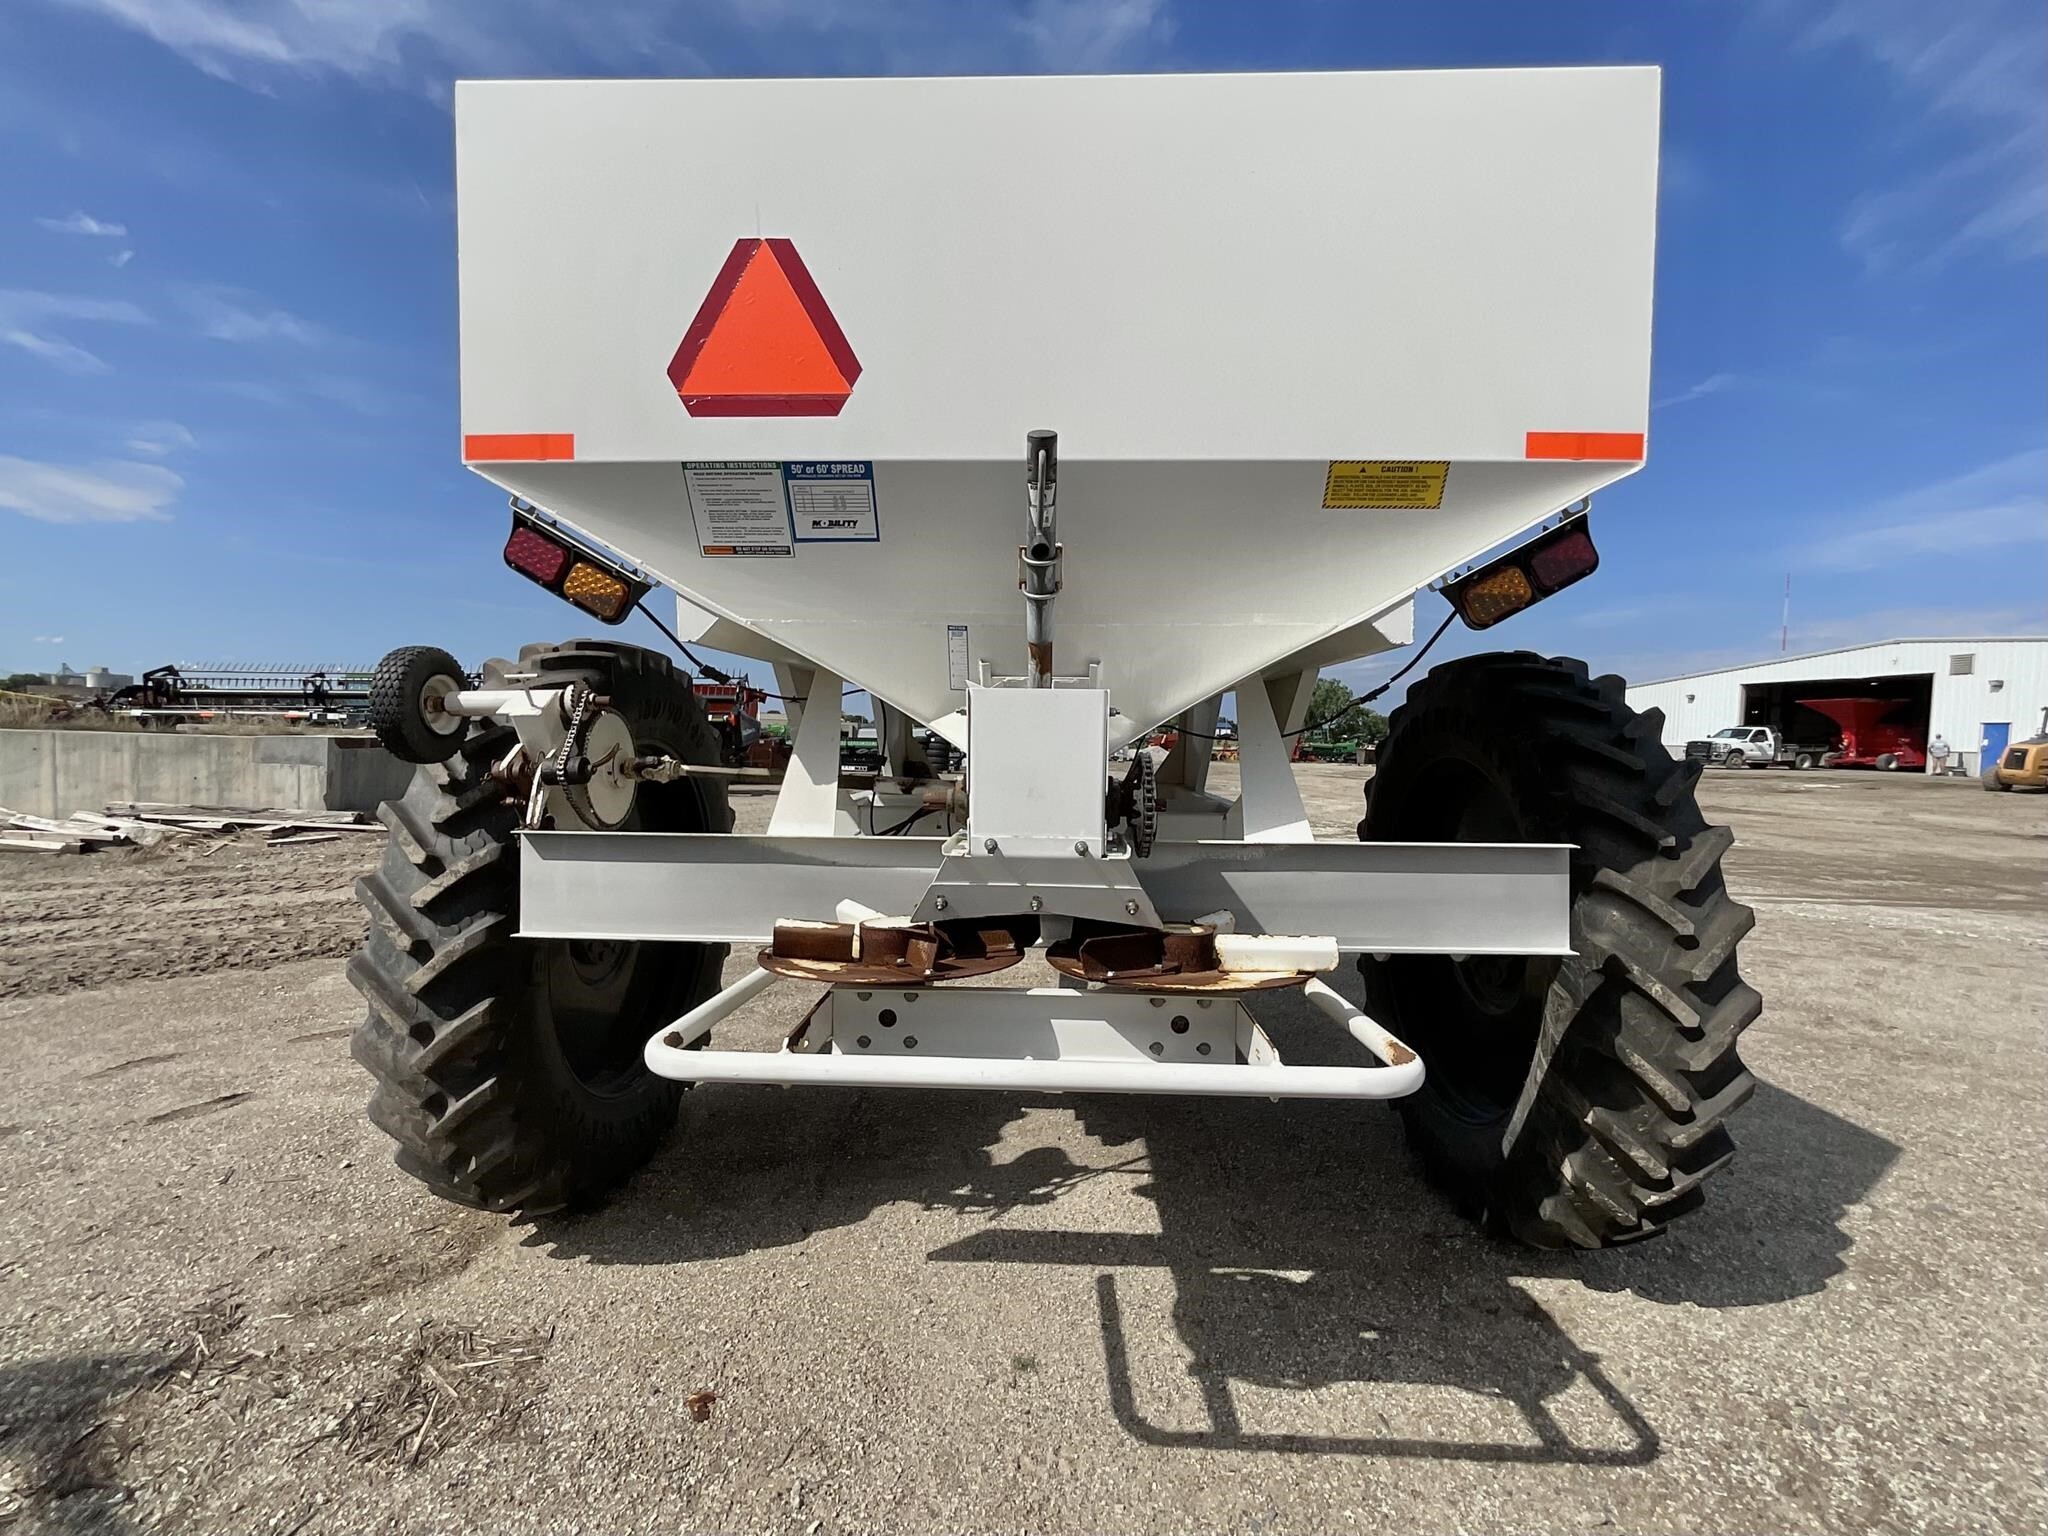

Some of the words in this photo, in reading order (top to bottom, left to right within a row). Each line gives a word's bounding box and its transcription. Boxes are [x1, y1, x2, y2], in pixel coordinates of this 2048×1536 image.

[791, 464, 803, 474] 50'
[805, 466, 815, 474] or
[816, 464, 829, 474] 60'
[831, 464, 865, 474] SPREAD
